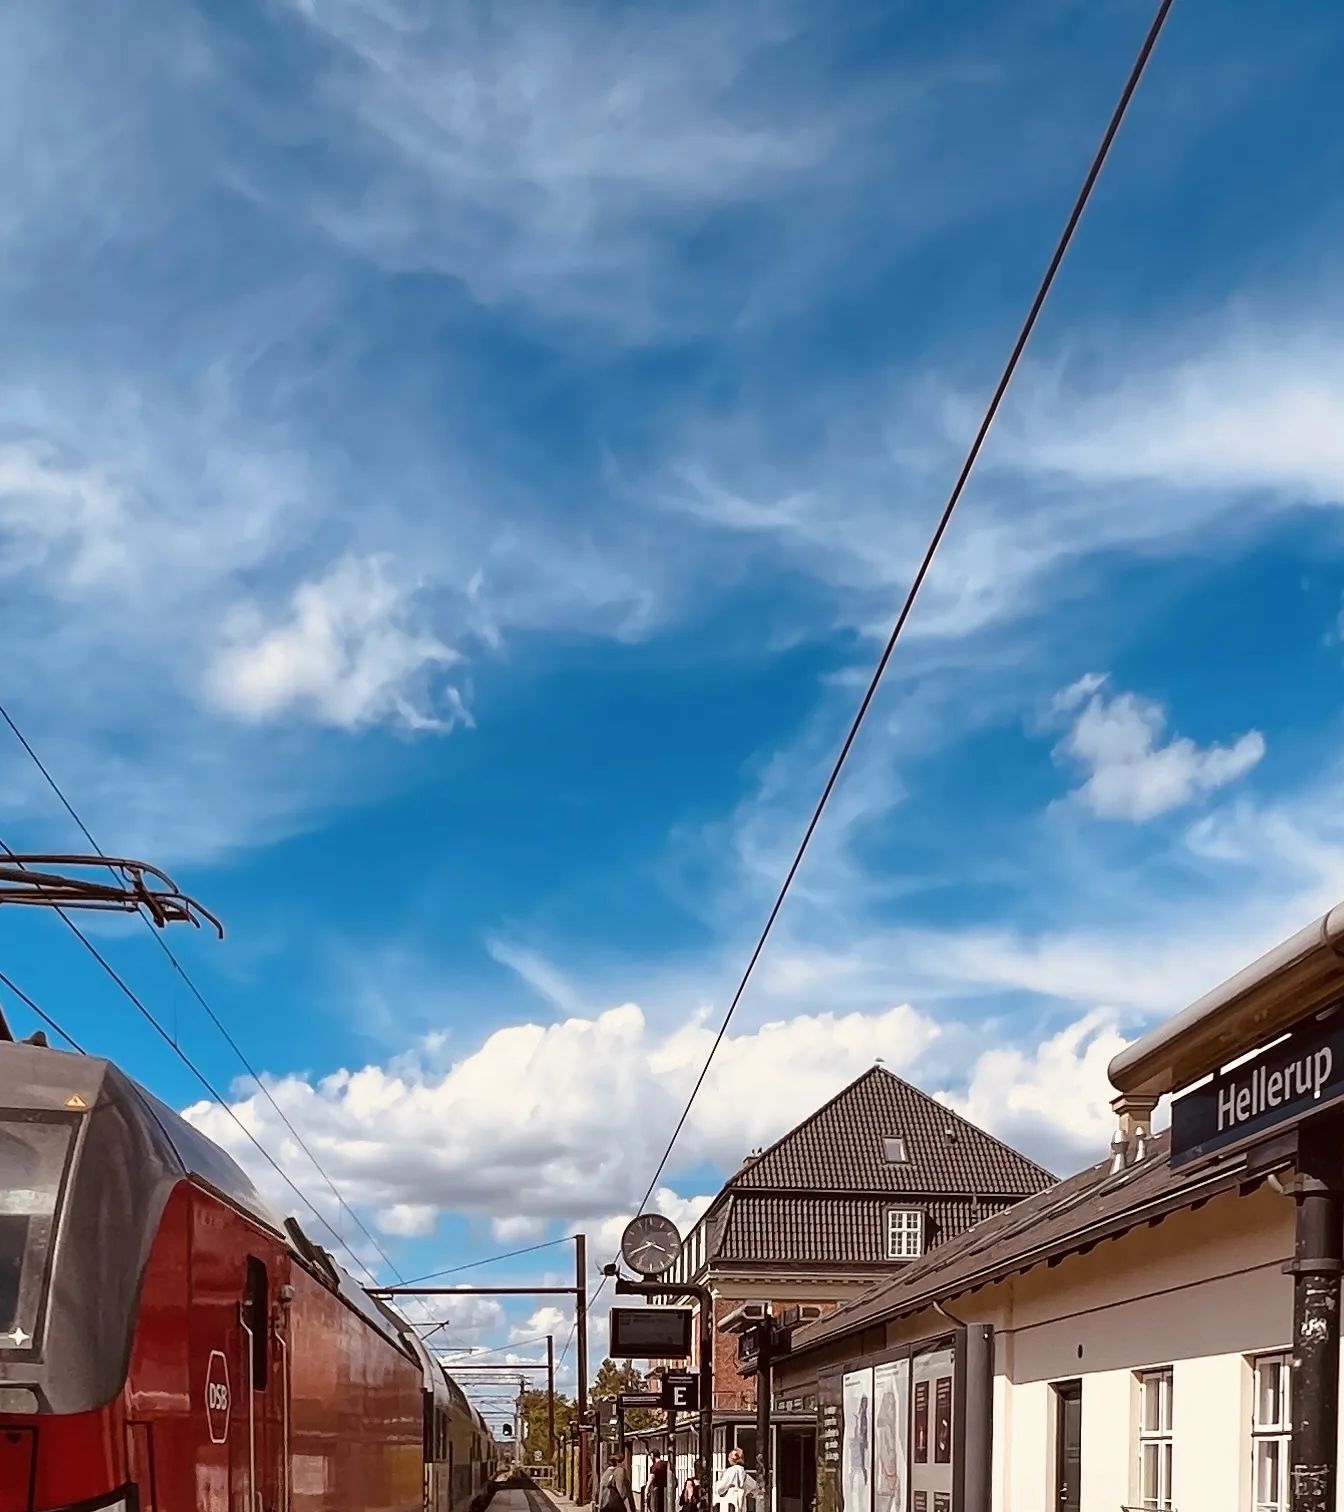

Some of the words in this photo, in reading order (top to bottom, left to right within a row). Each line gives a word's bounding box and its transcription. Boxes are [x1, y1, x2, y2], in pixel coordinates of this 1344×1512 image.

[1216, 1043, 1334, 1132] Hellerup
[208, 1382, 228, 1412] DSB
[673, 1386, 687, 1406] E
